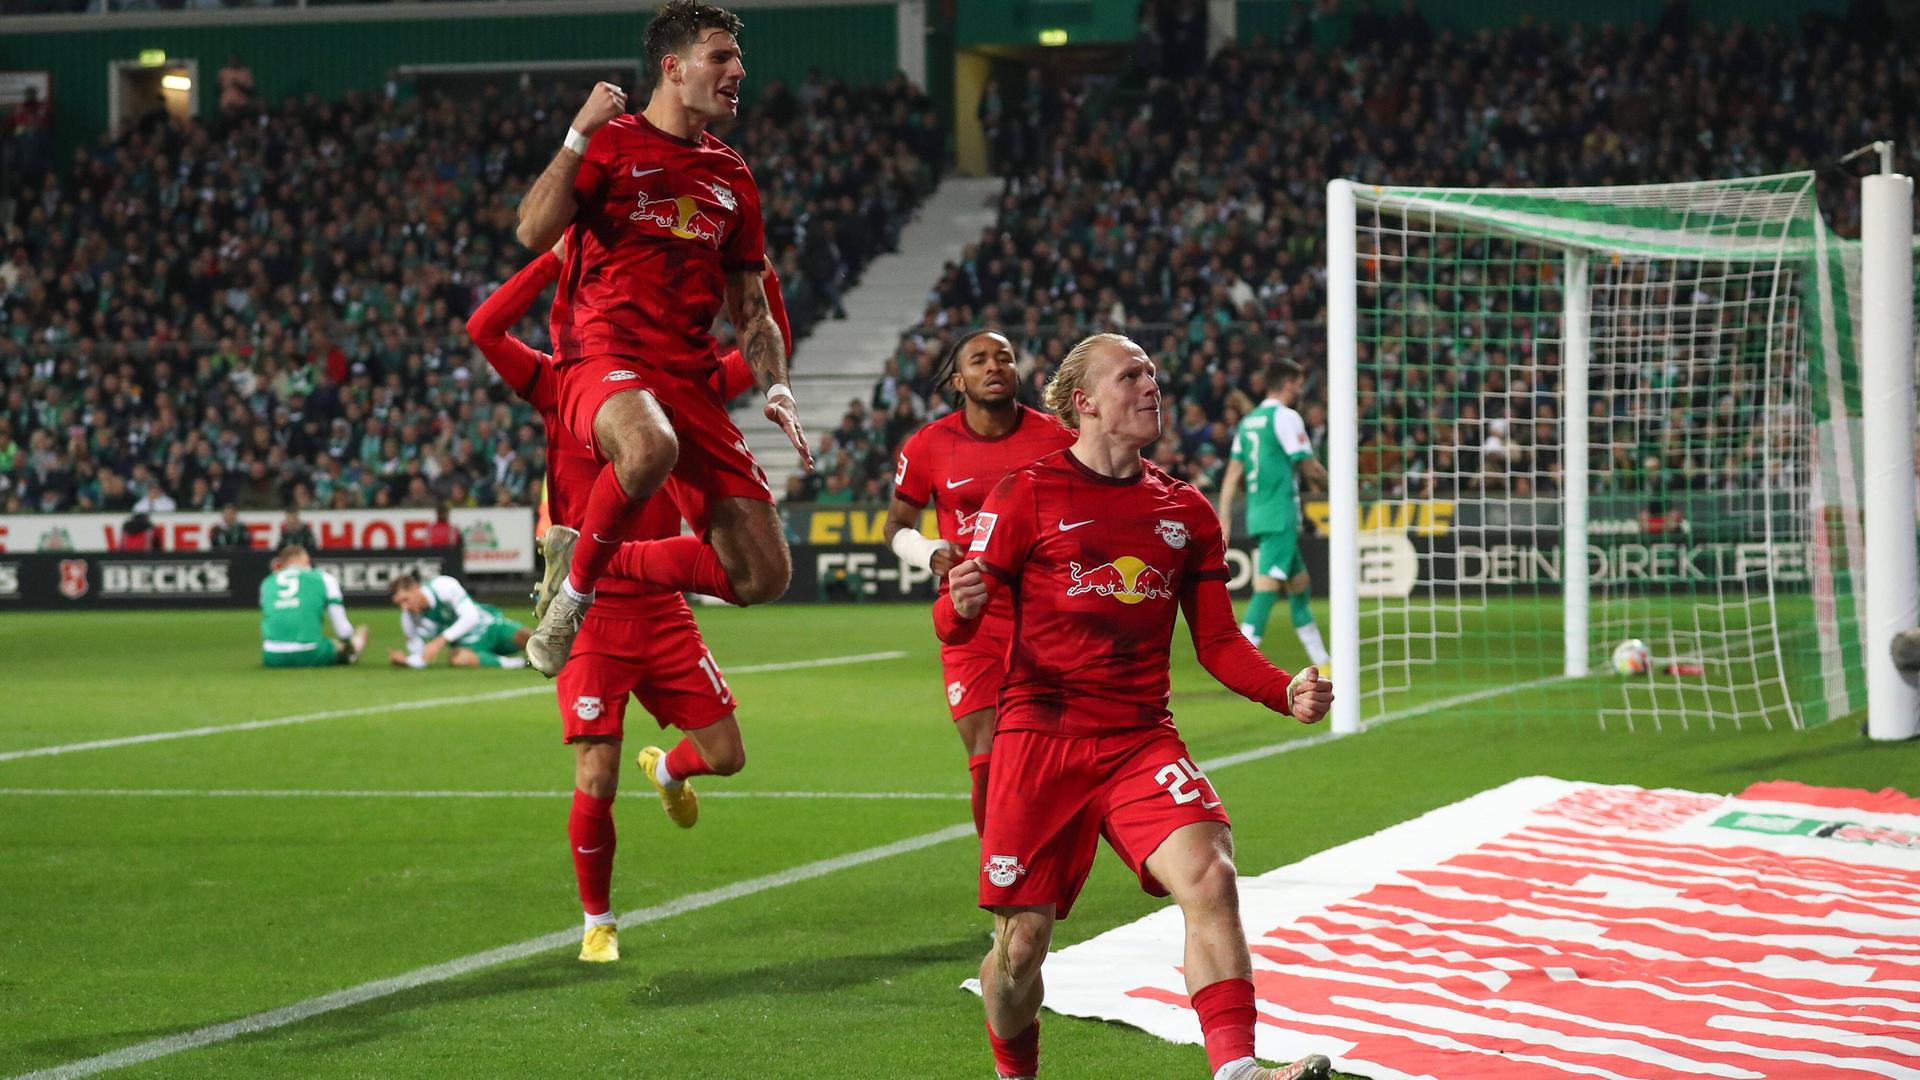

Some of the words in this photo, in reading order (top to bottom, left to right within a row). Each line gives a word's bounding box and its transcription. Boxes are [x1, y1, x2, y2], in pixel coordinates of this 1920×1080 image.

[102, 562, 229, 592] BECK'S
[1458, 545, 1560, 582] DEIN
[276, 570, 300, 597] 5
[1154, 757, 1219, 805] 24
